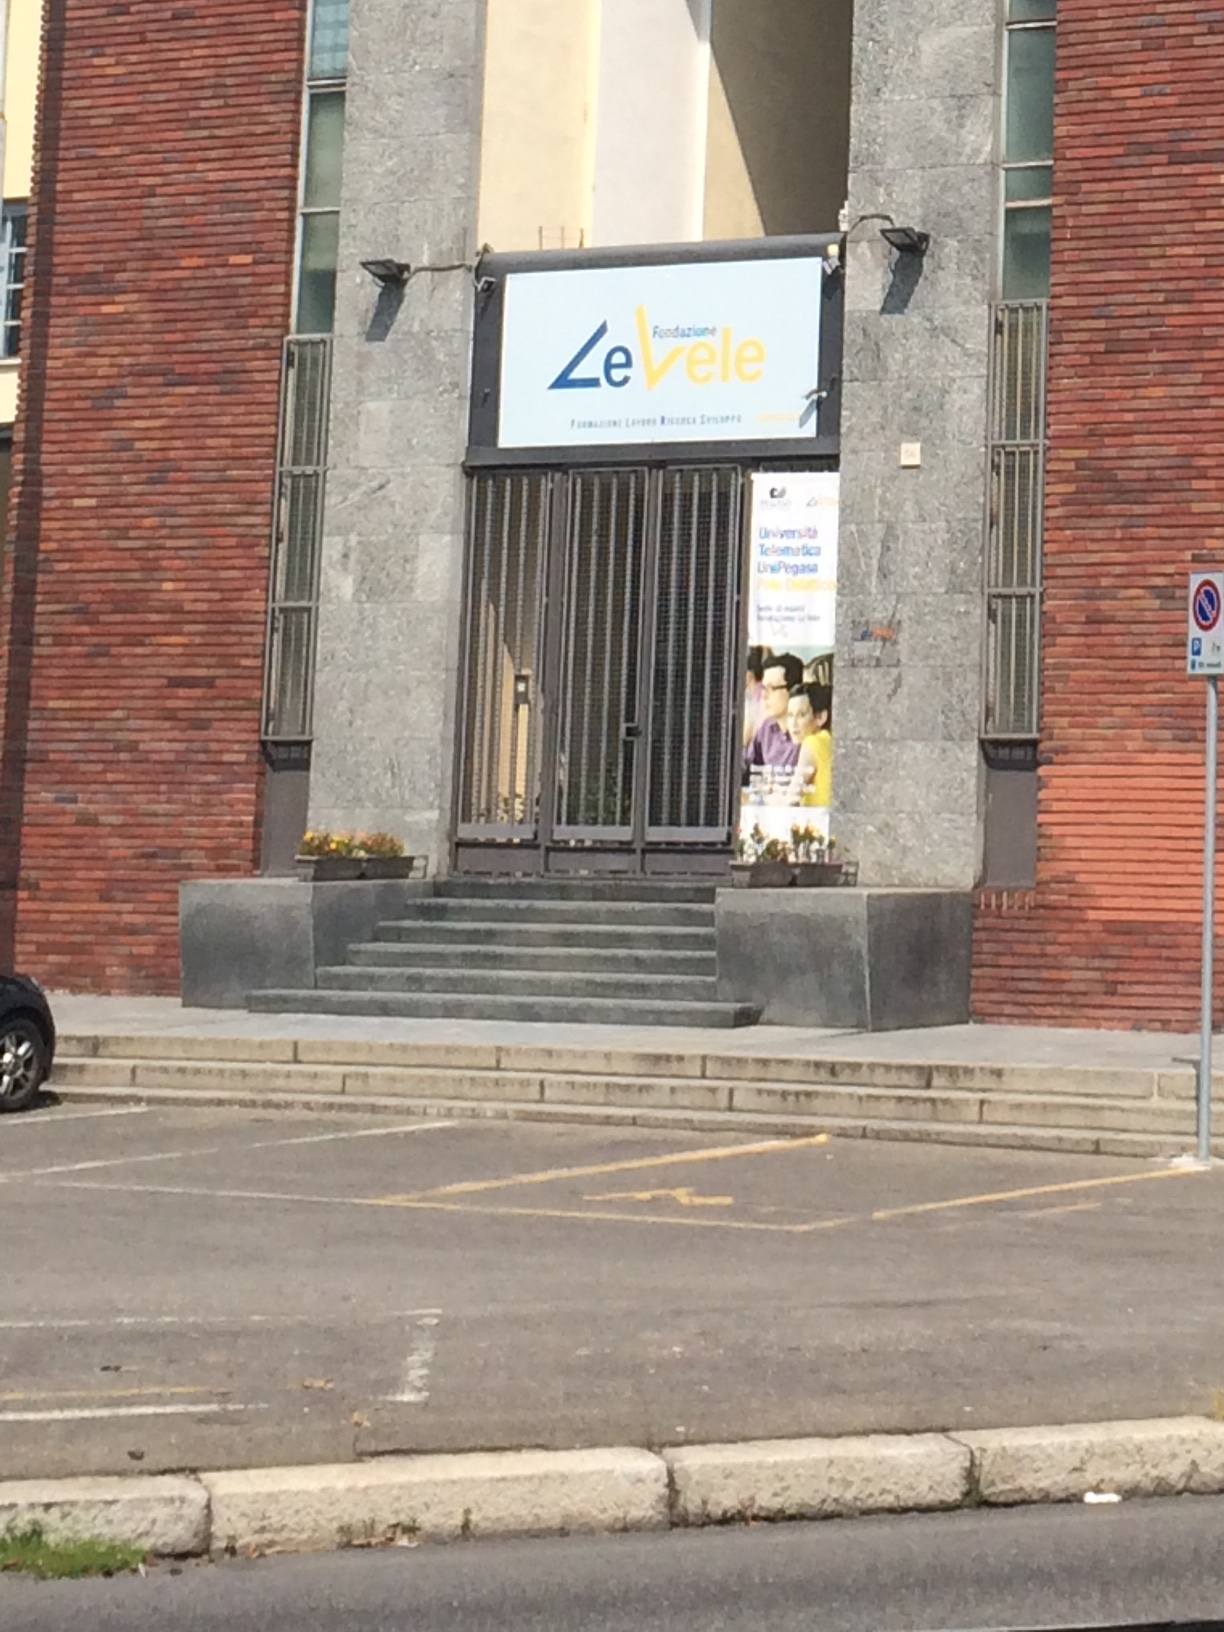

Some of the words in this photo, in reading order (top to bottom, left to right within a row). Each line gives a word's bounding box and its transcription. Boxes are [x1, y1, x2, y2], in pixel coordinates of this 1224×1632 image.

[652, 324, 717, 341] Fondazione
[758, 524, 819, 541] Università
[758, 543, 822, 557] Telematica
